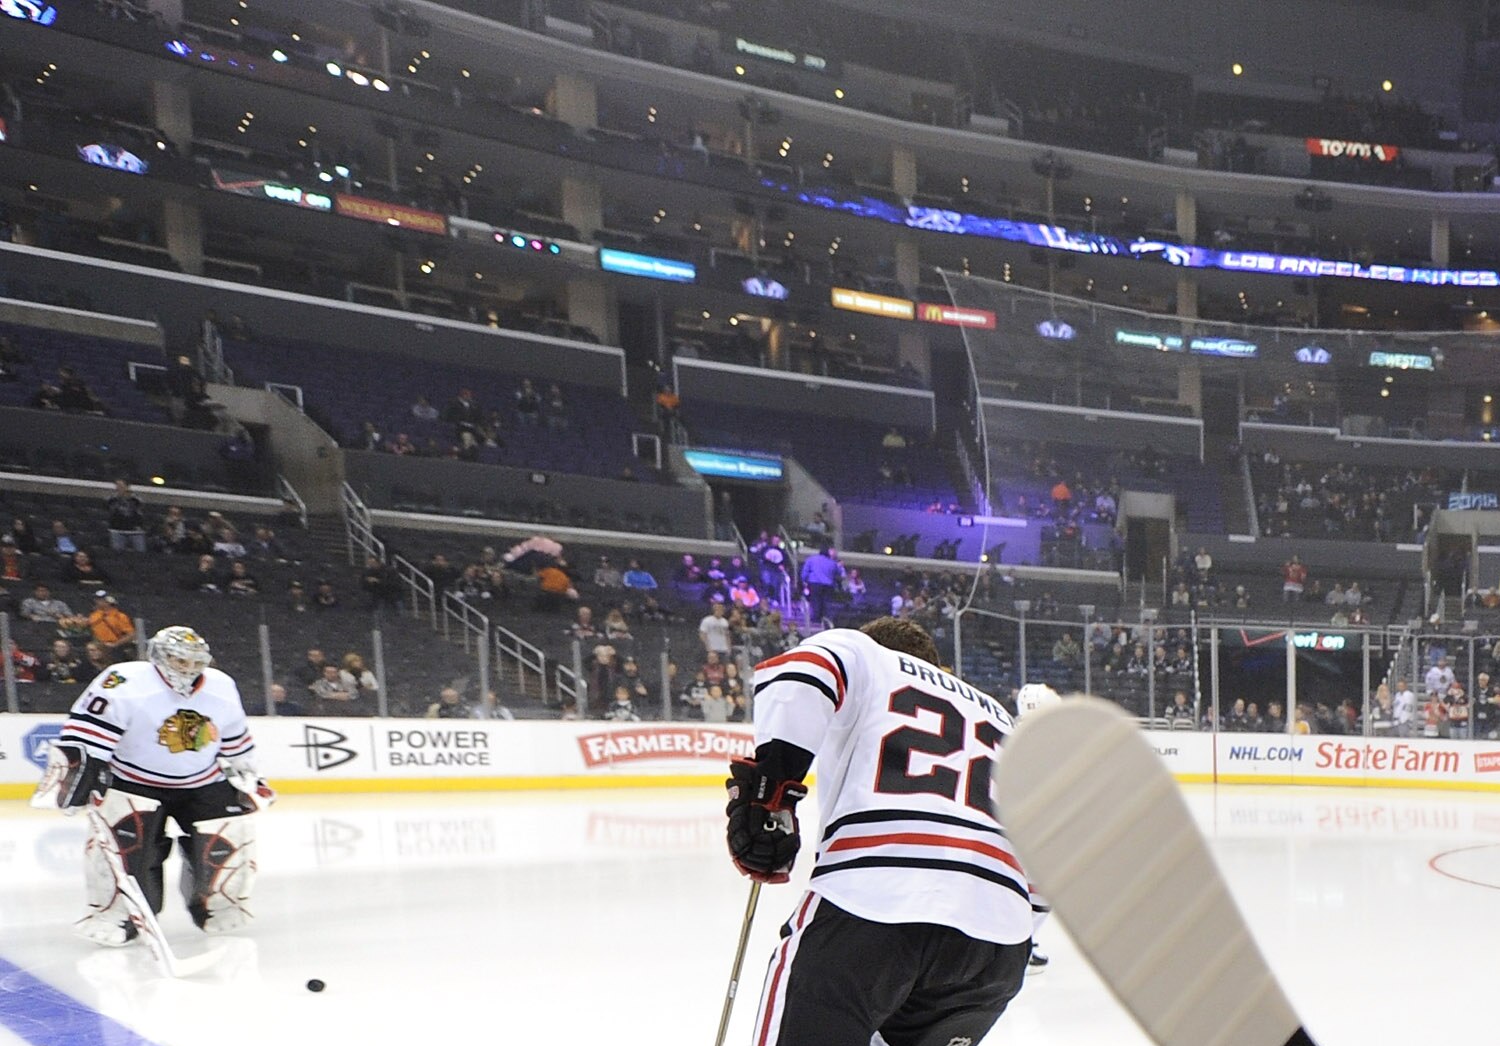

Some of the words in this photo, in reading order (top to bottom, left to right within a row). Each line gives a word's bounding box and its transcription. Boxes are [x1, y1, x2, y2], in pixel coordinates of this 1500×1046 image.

[1223, 252, 1275, 271] LOS
[1279, 256, 1406, 282] ANGELES
[388, 731, 488, 749] POWER
[590, 733, 692, 764] FARMER
[390, 751, 491, 766] BALANCE
[1229, 745, 1304, 761] NHL.COM
[1314, 740, 1387, 770] State
[1391, 744, 1462, 773] Farm
